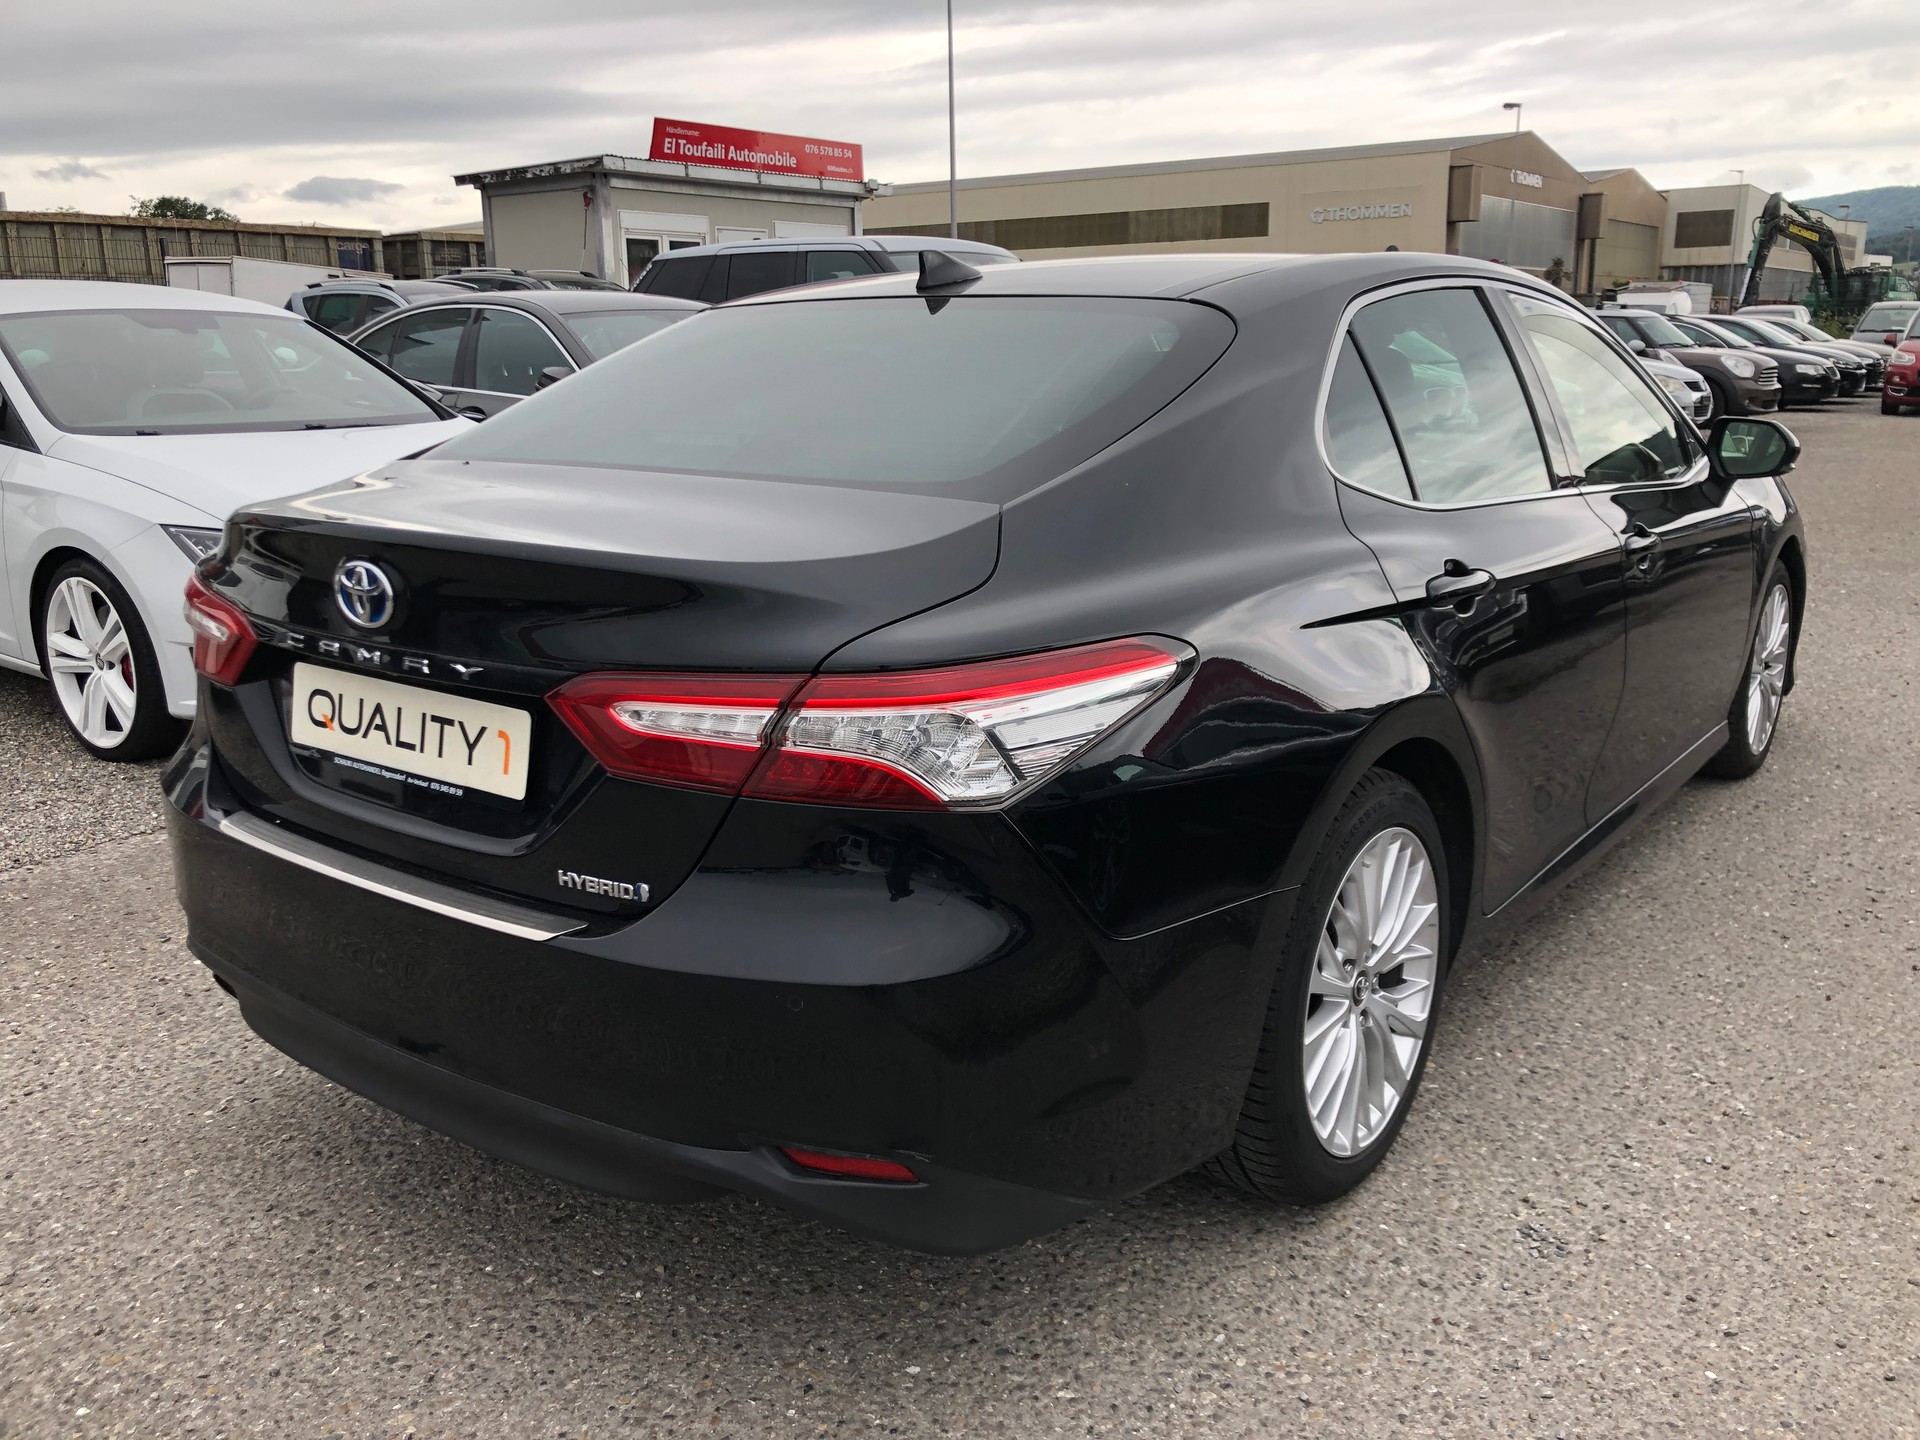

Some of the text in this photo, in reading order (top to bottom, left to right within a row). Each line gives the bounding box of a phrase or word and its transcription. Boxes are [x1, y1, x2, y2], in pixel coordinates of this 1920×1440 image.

[664, 138, 797, 167] El Toufaili Automobile
[805, 144, 819, 154] 076
[820, 146, 833, 156] 578
[843, 149, 852, 158] 54
[1327, 203, 1413, 221] THOMMEN
[287, 631, 484, 680] CAMRY
[558, 870, 634, 900] HYBRID
